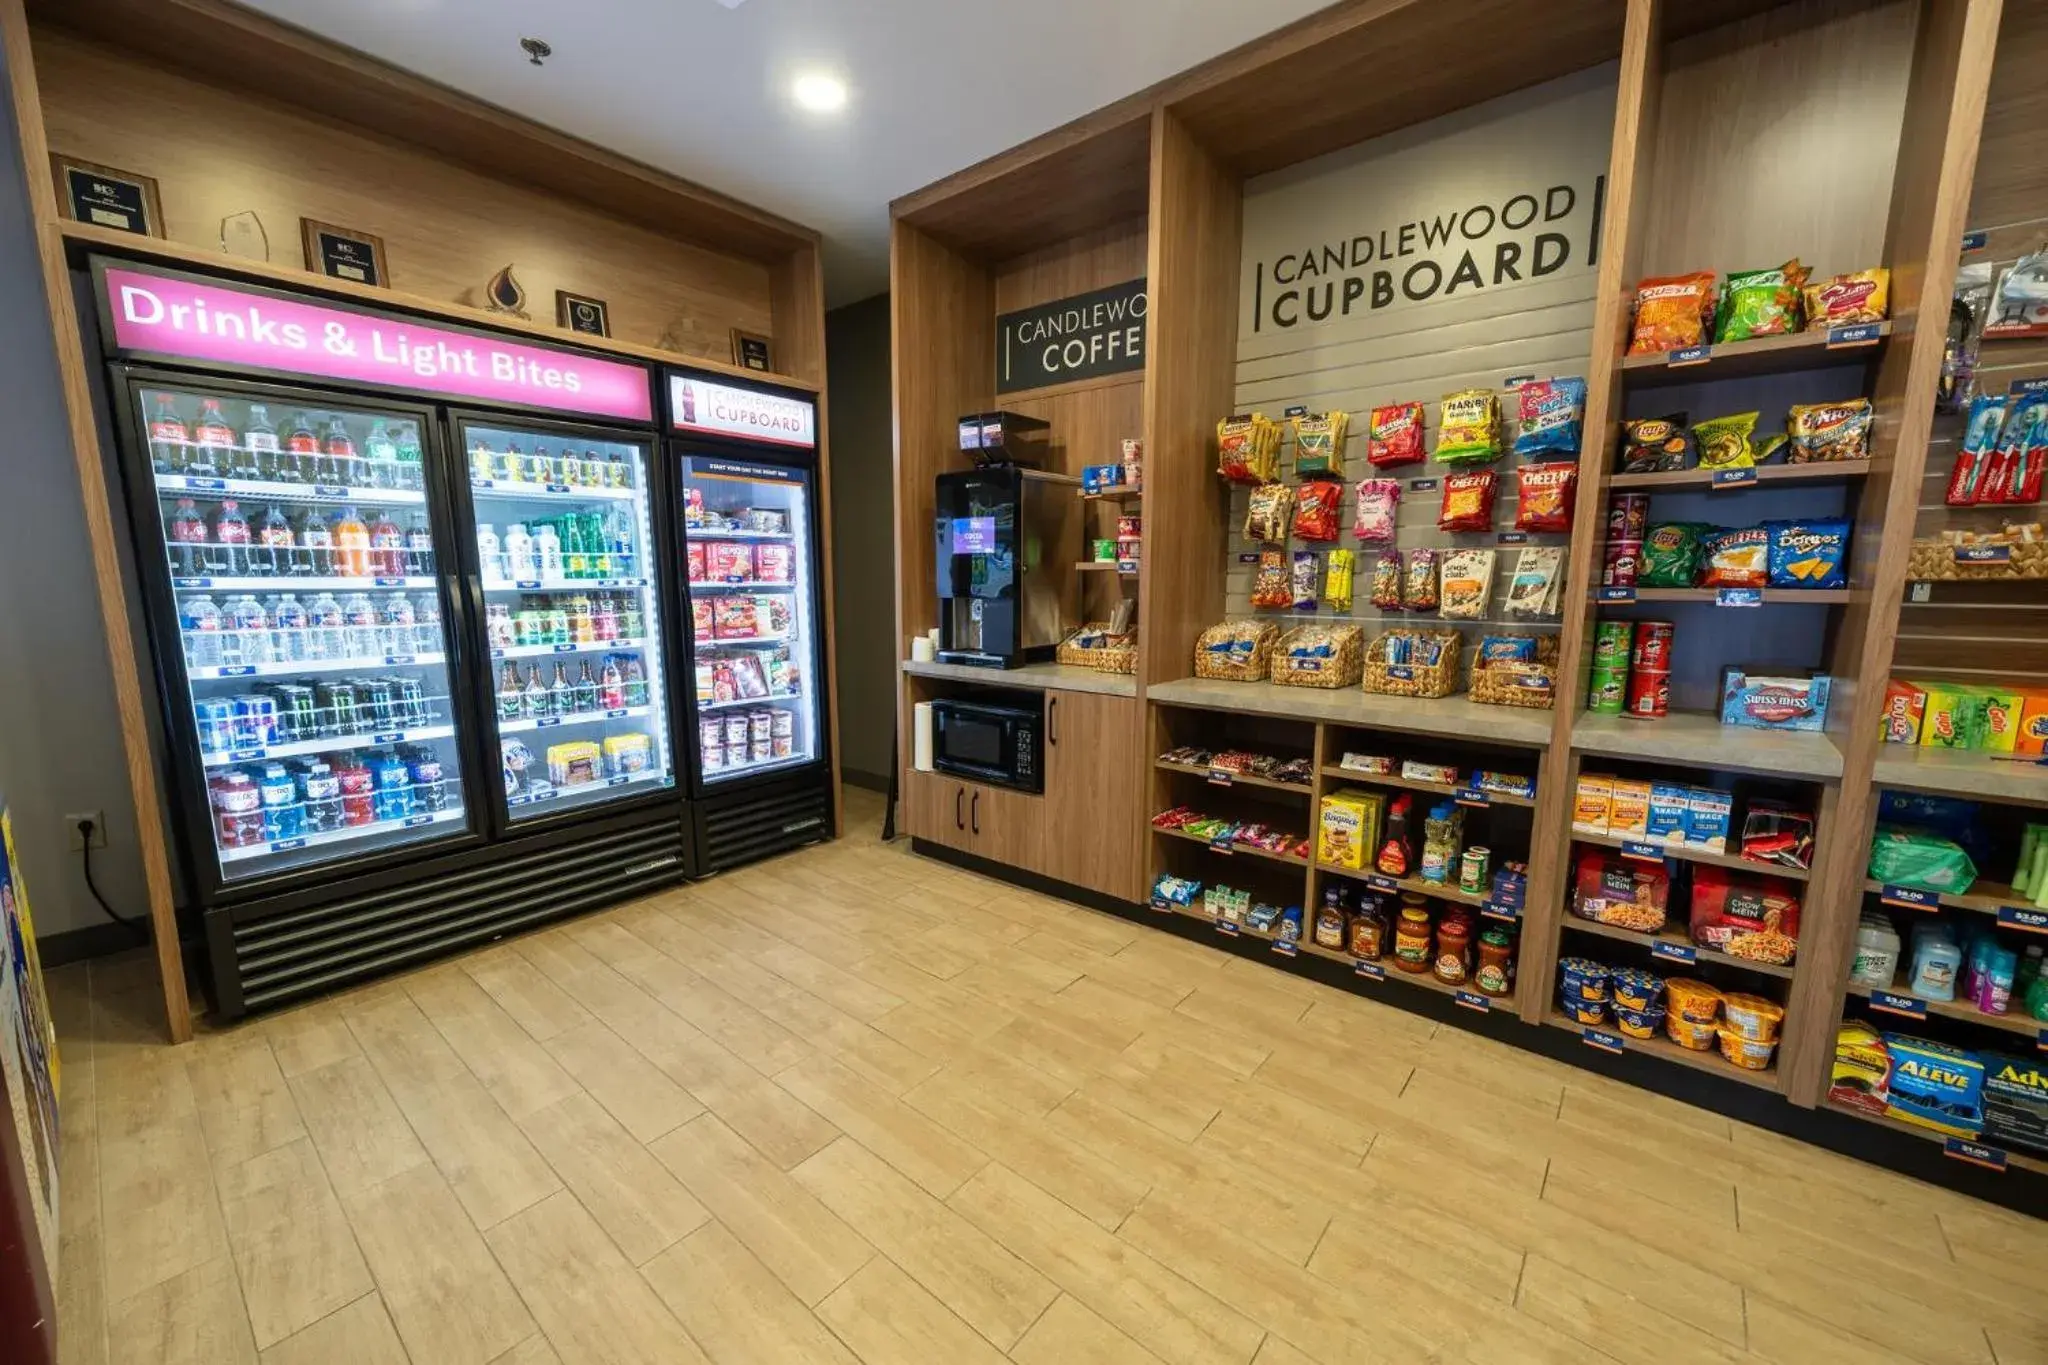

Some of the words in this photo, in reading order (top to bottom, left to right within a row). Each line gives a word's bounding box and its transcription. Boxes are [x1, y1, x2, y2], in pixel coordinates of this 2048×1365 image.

[1272, 184, 1577, 286] CANDLEWOOD
[1272, 231, 1571, 328] CUPBOARD
[1018, 292, 1148, 344] CANDLEWO
[120, 284, 308, 350] Drinks
[321, 321, 359, 358] &
[372, 329, 480, 378] Light
[490, 350, 583, 394] Bites
[1042, 326, 1141, 372] COFFE
[714, 405, 801, 432] CUPBOARD
[1779, 532, 1841, 554] Doritos
[1606, 872, 1632, 883] CHOW
[1607, 881, 1630, 891] MEIN
[1731, 898, 1761, 910] CHOW
[1731, 907, 1760, 918] MEIN
[1898, 1059, 1970, 1089] ALEVE
